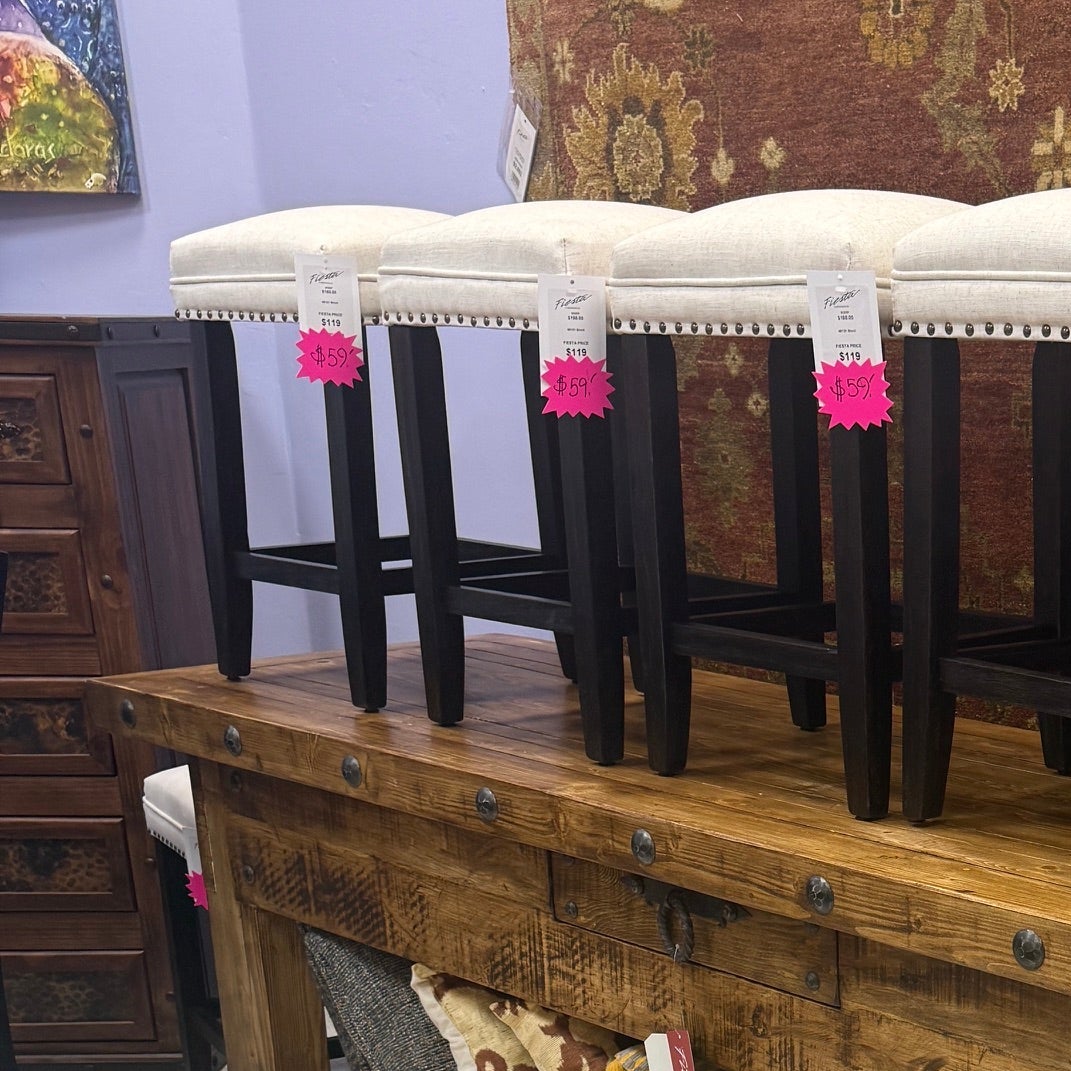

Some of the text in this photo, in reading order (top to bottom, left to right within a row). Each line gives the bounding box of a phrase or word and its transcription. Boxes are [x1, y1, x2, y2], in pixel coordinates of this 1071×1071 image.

[308, 270, 345, 285] Fiesta
[554, 293, 593, 310] Fiesta
[823, 289, 861, 309] Fiesta
[321, 318, 341, 327] $119
[565, 347, 587, 357] $119
[838, 351, 861, 361] $119
